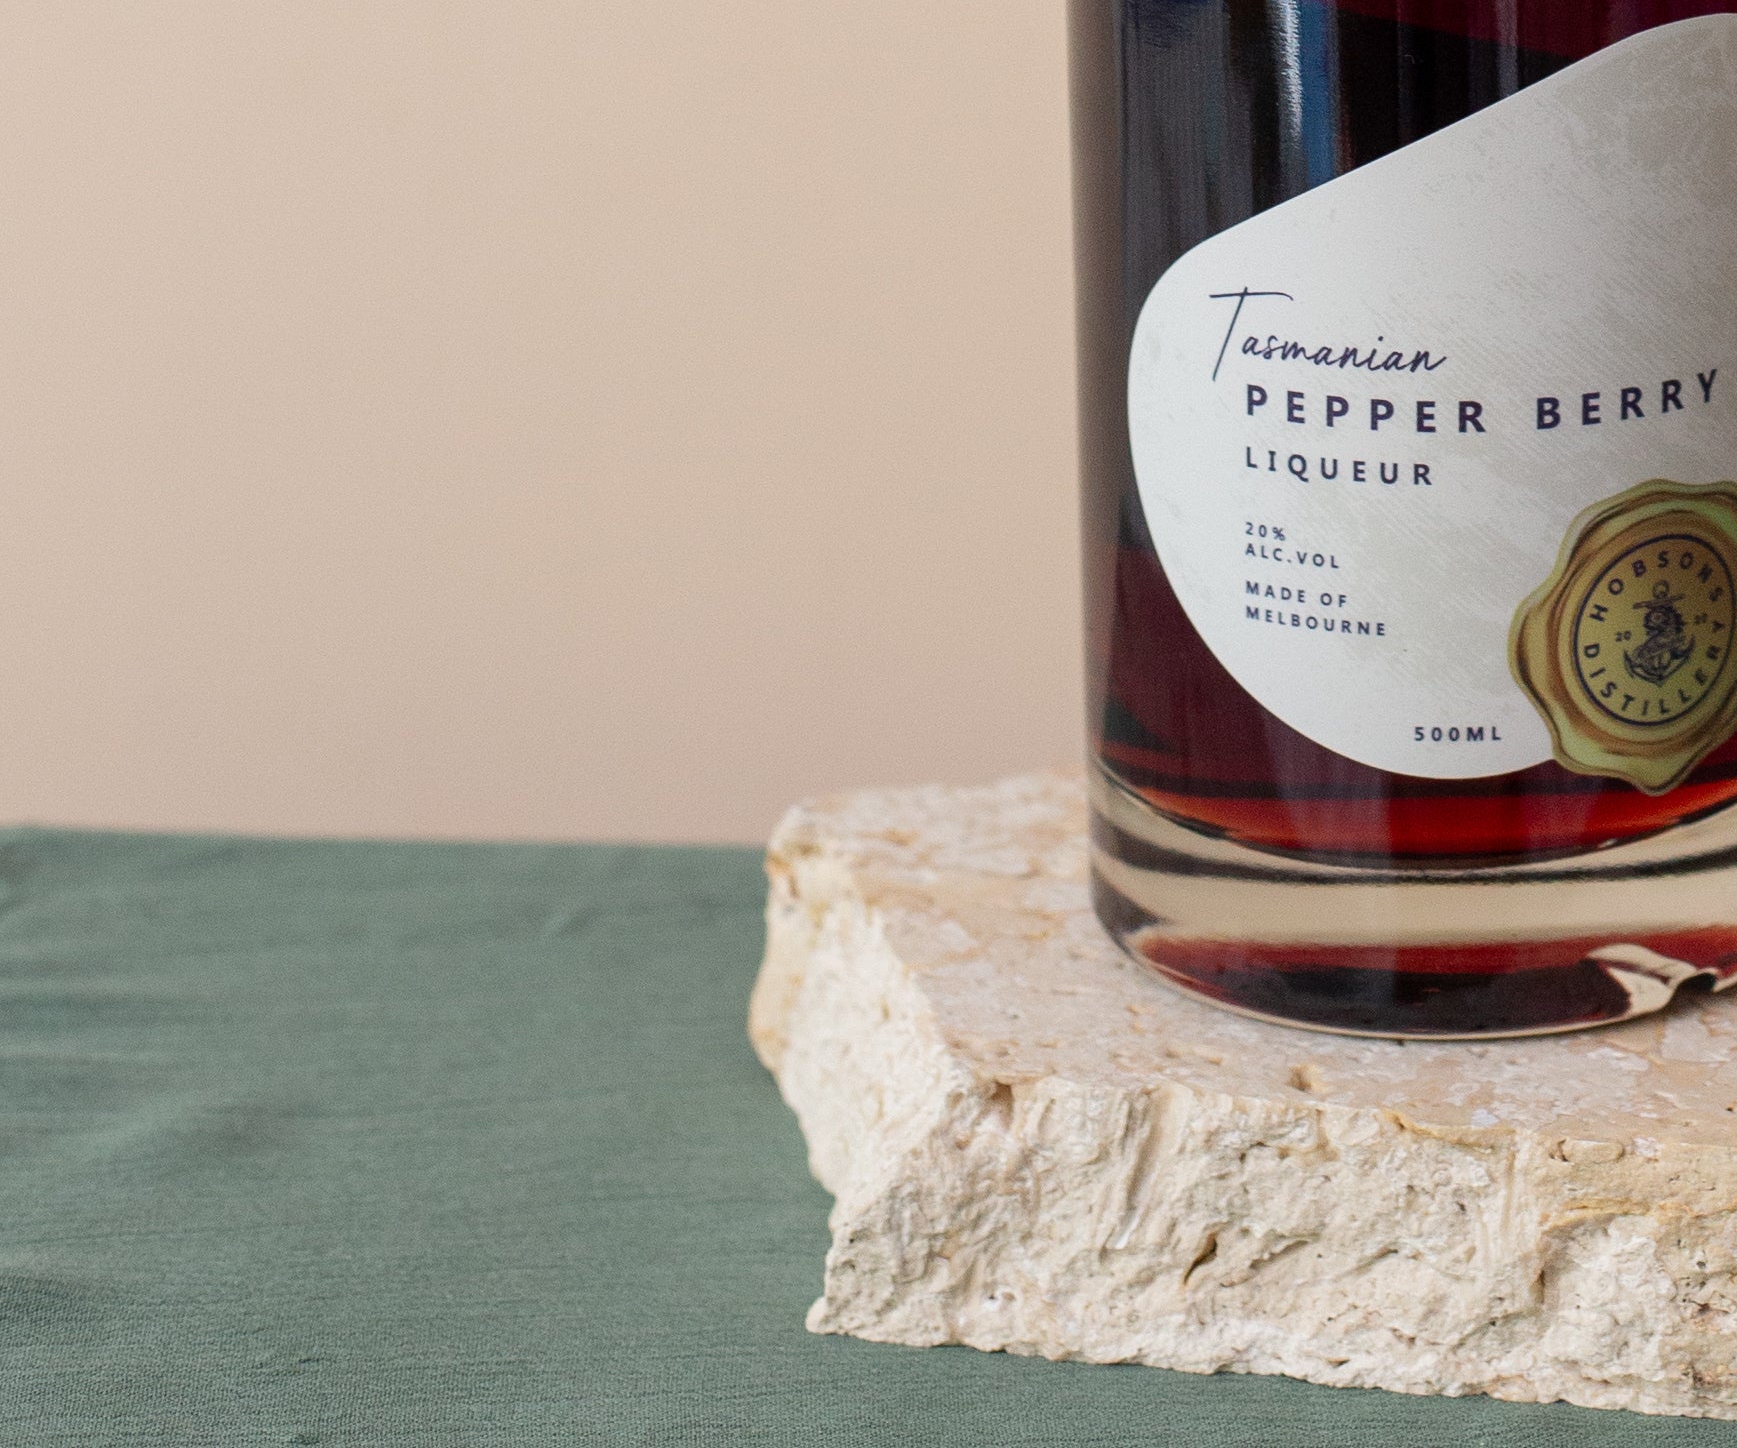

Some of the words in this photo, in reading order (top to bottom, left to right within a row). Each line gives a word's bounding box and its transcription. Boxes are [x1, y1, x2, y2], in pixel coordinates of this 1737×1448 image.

[1209, 286, 1448, 382] Tasmanian
[1246, 383, 1488, 435] PEPPER
[1536, 367, 1719, 430] BERRY
[1245, 446, 1433, 487] LIQUEUR
[1245, 521, 1287, 542] 20%
[1245, 543, 1341, 570] ALC.VOL
[1245, 580, 1306, 604] MADE
[1319, 592, 1347, 608] OF
[1588, 550, 1724, 622] HOBSONS
[1245, 606, 1386, 637] MELBOURNE
[1414, 725, 1502, 743] 500ML
